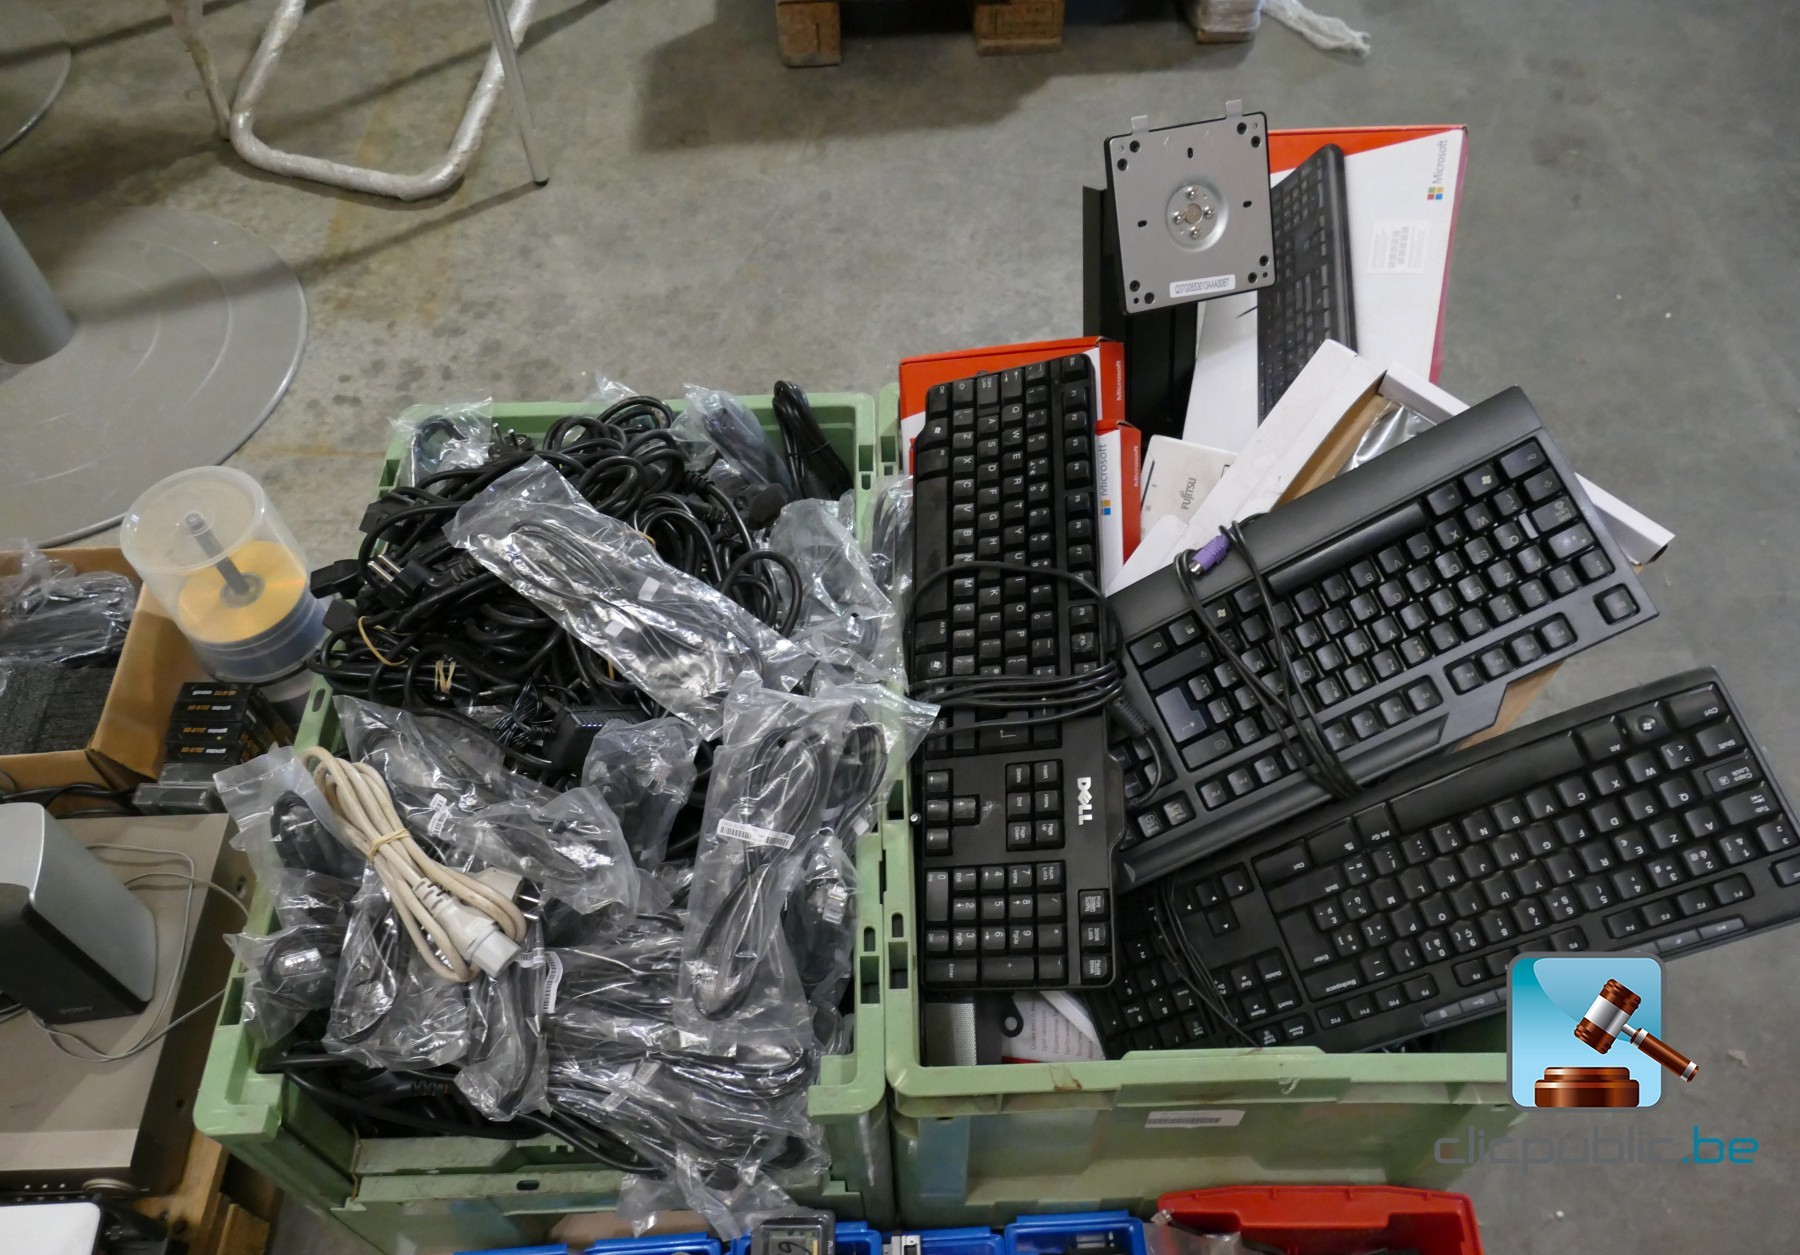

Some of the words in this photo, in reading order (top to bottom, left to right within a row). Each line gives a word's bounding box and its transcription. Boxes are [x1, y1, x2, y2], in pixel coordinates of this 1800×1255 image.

[1433, 140, 1448, 184] Microsoft
[1100, 444, 1108, 497] Microsoft
[1180, 477, 1196, 510] FUJITSU
[1077, 776, 1092, 825] DELL
